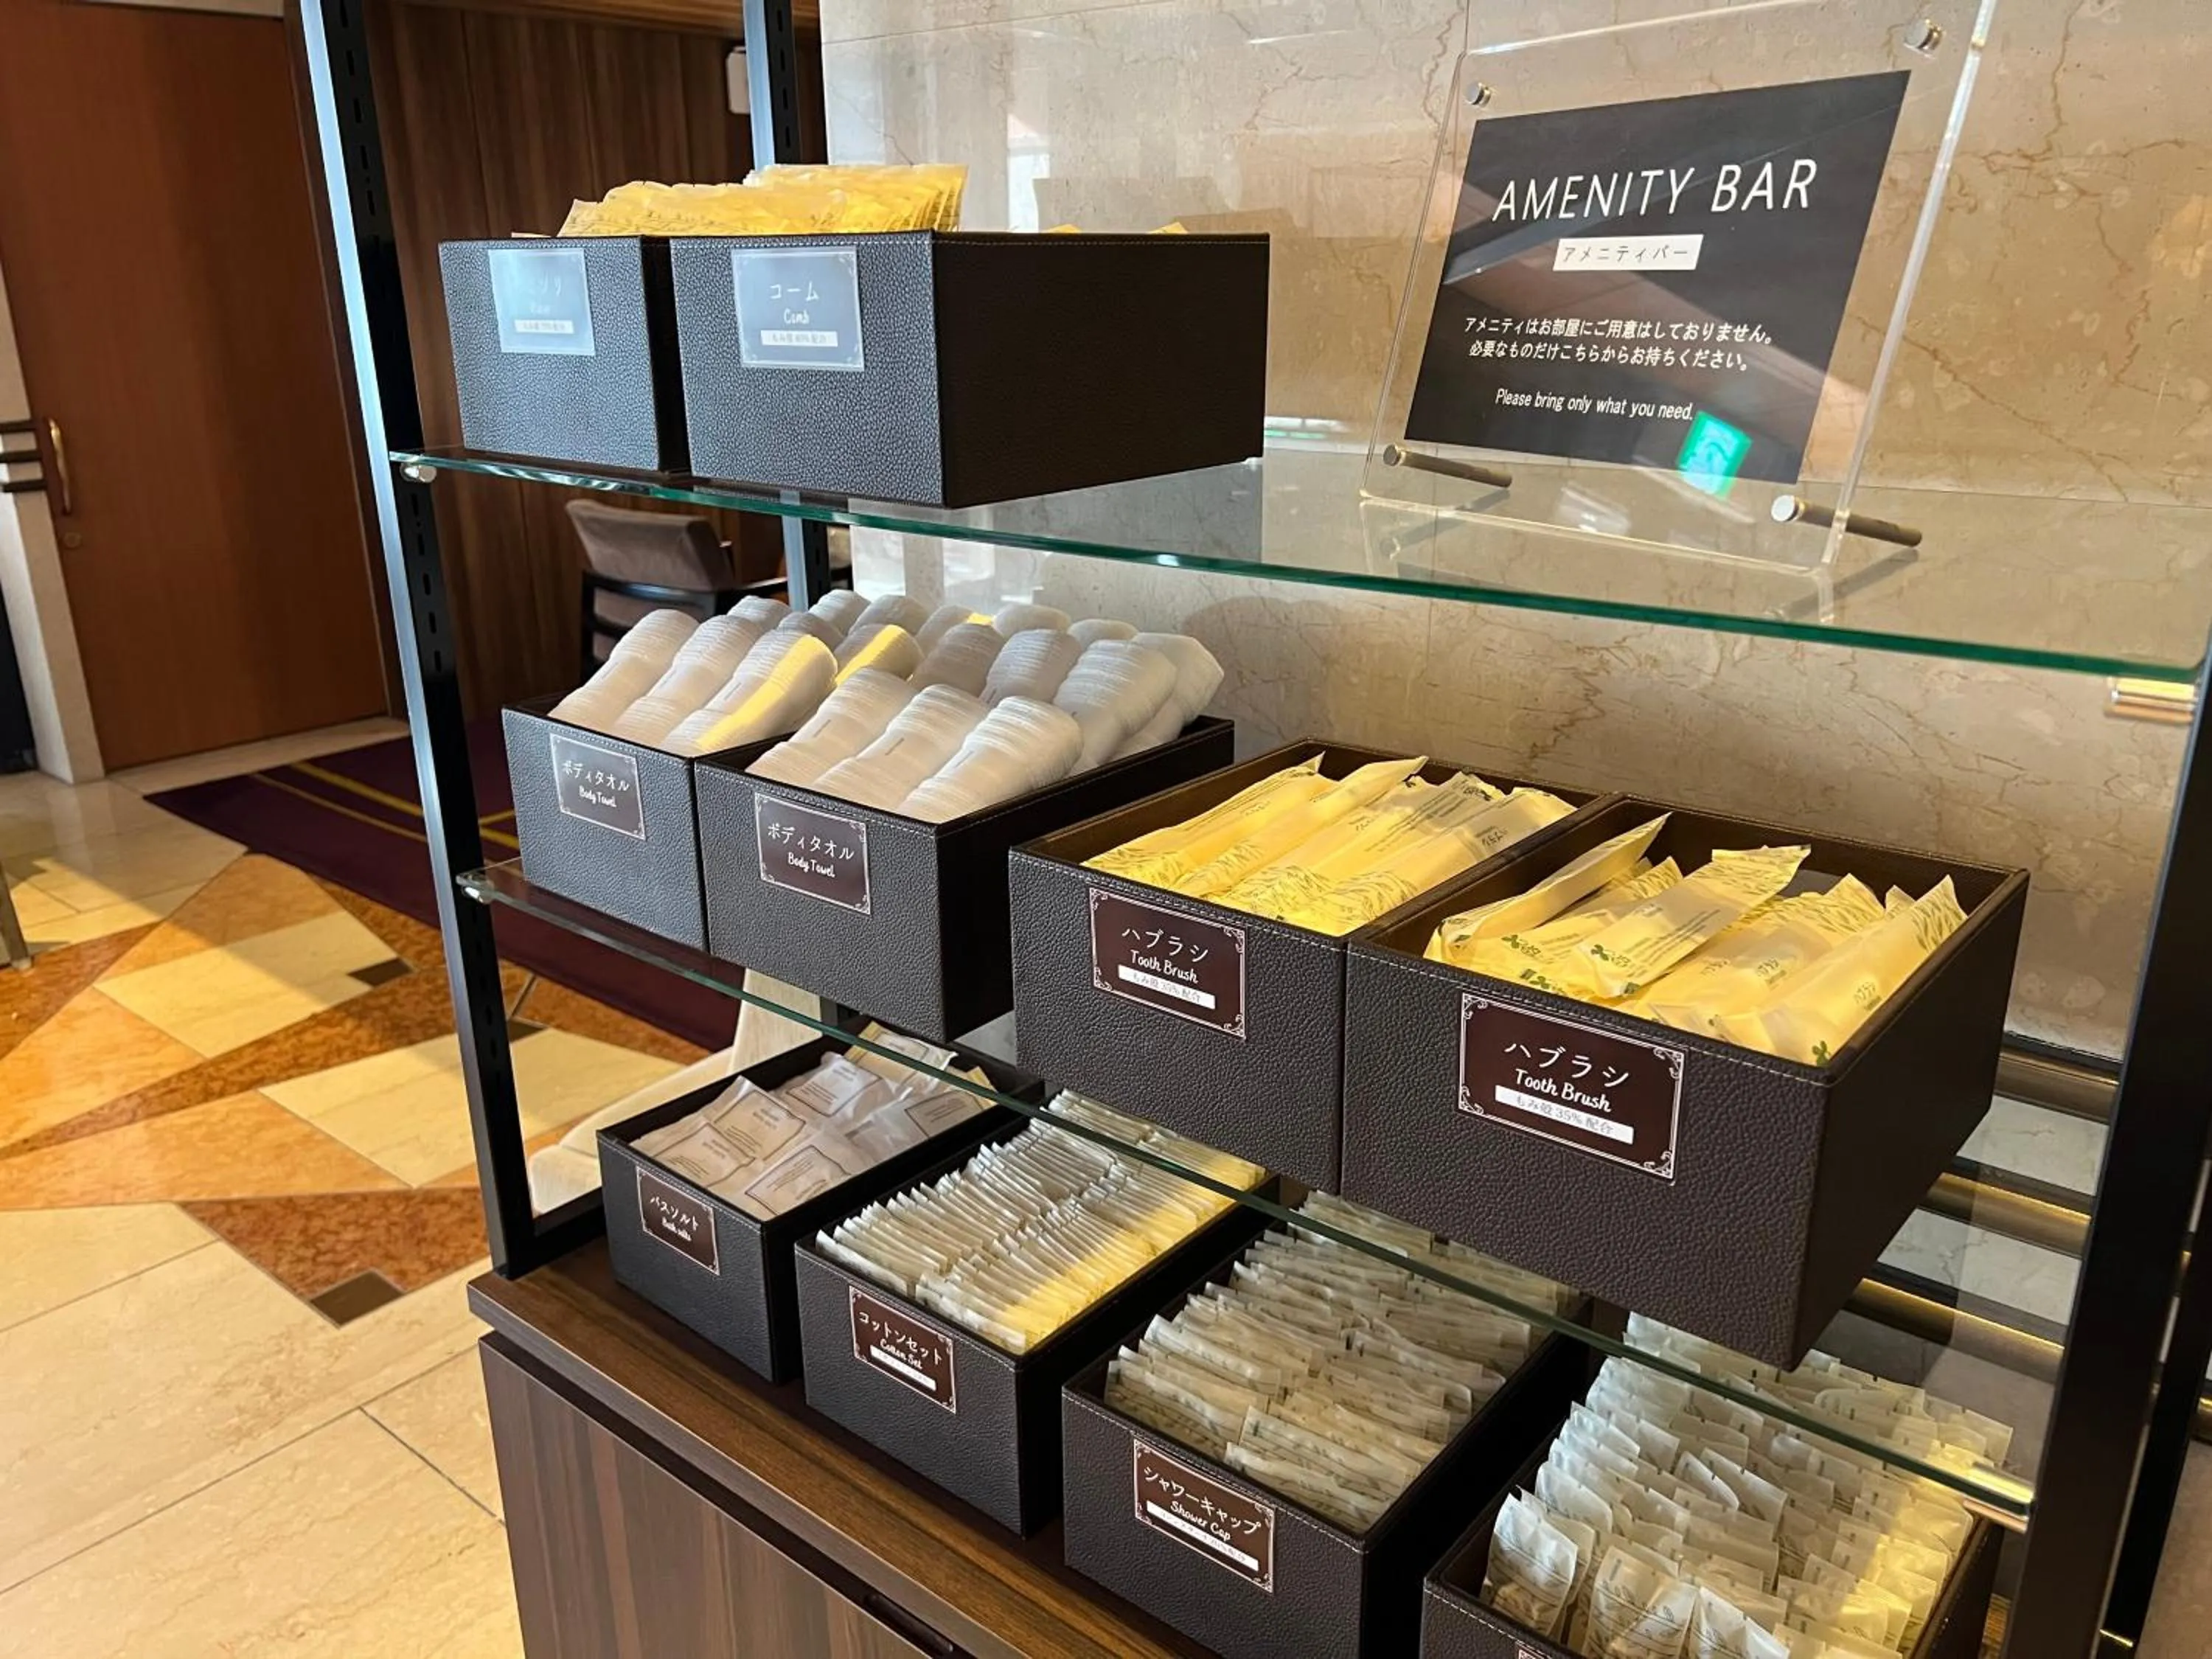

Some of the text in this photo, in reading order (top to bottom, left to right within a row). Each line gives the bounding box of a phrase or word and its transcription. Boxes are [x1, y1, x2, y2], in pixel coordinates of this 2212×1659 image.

[1492, 159, 1817, 221] AMENITY BAR
[1562, 244, 1688, 263] アメニティバー
[769, 281, 819, 302] コーム
[1465, 317, 1773, 345] アメニティはお部屋にご用意はしておりません。
[1469, 340, 1747, 371] 必要なものだけこちらからお持ちください。
[1495, 388, 1693, 420] Please bring only what you need.
[563, 760, 630, 791] ボディタオル
[579, 785, 616, 807] Body Towel
[768, 823, 854, 860] ボディタオル
[787, 852, 835, 877] Body Towel
[1121, 928, 1208, 962] ハブラシ
[1130, 949, 1199, 984] Tooth Brush
[1505, 1043, 1630, 1088] ハブラシ
[1515, 1068, 1612, 1113] Tooth Brush
[859, 1311, 942, 1365] コットンセット
[908, 1354, 922, 1370] Set
[1144, 1467, 1262, 1534] シャワーキャップ
[1170, 1500, 1208, 1528] Shower
[1211, 1523, 1231, 1542] Cap
